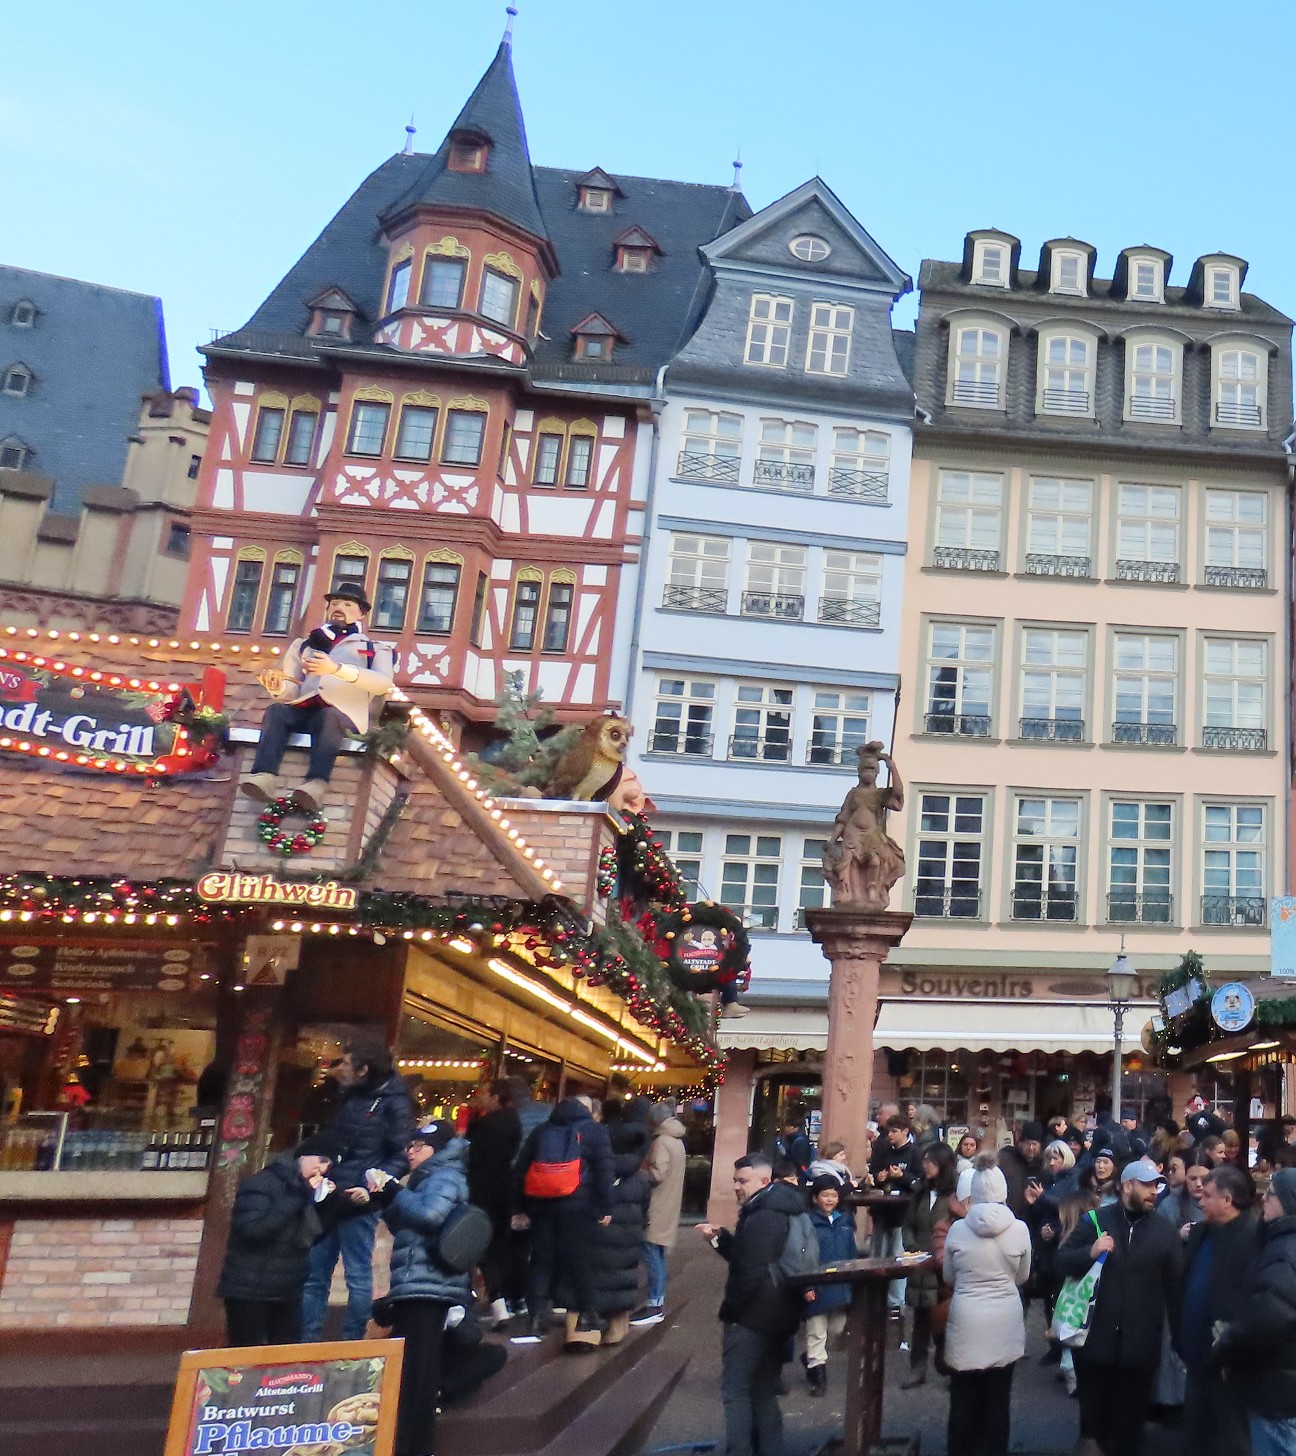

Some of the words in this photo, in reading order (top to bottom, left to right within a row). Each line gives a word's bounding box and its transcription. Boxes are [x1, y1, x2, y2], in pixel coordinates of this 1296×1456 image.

[197, 872, 358, 910] Glühwein
[683, 958, 718, 966] ALTSTADT-
[901, 972, 1033, 998] Souvenirs
[255, 1383, 324, 1398] Altstadt-Grill
[202, 1401, 296, 1422] Bratwurst
